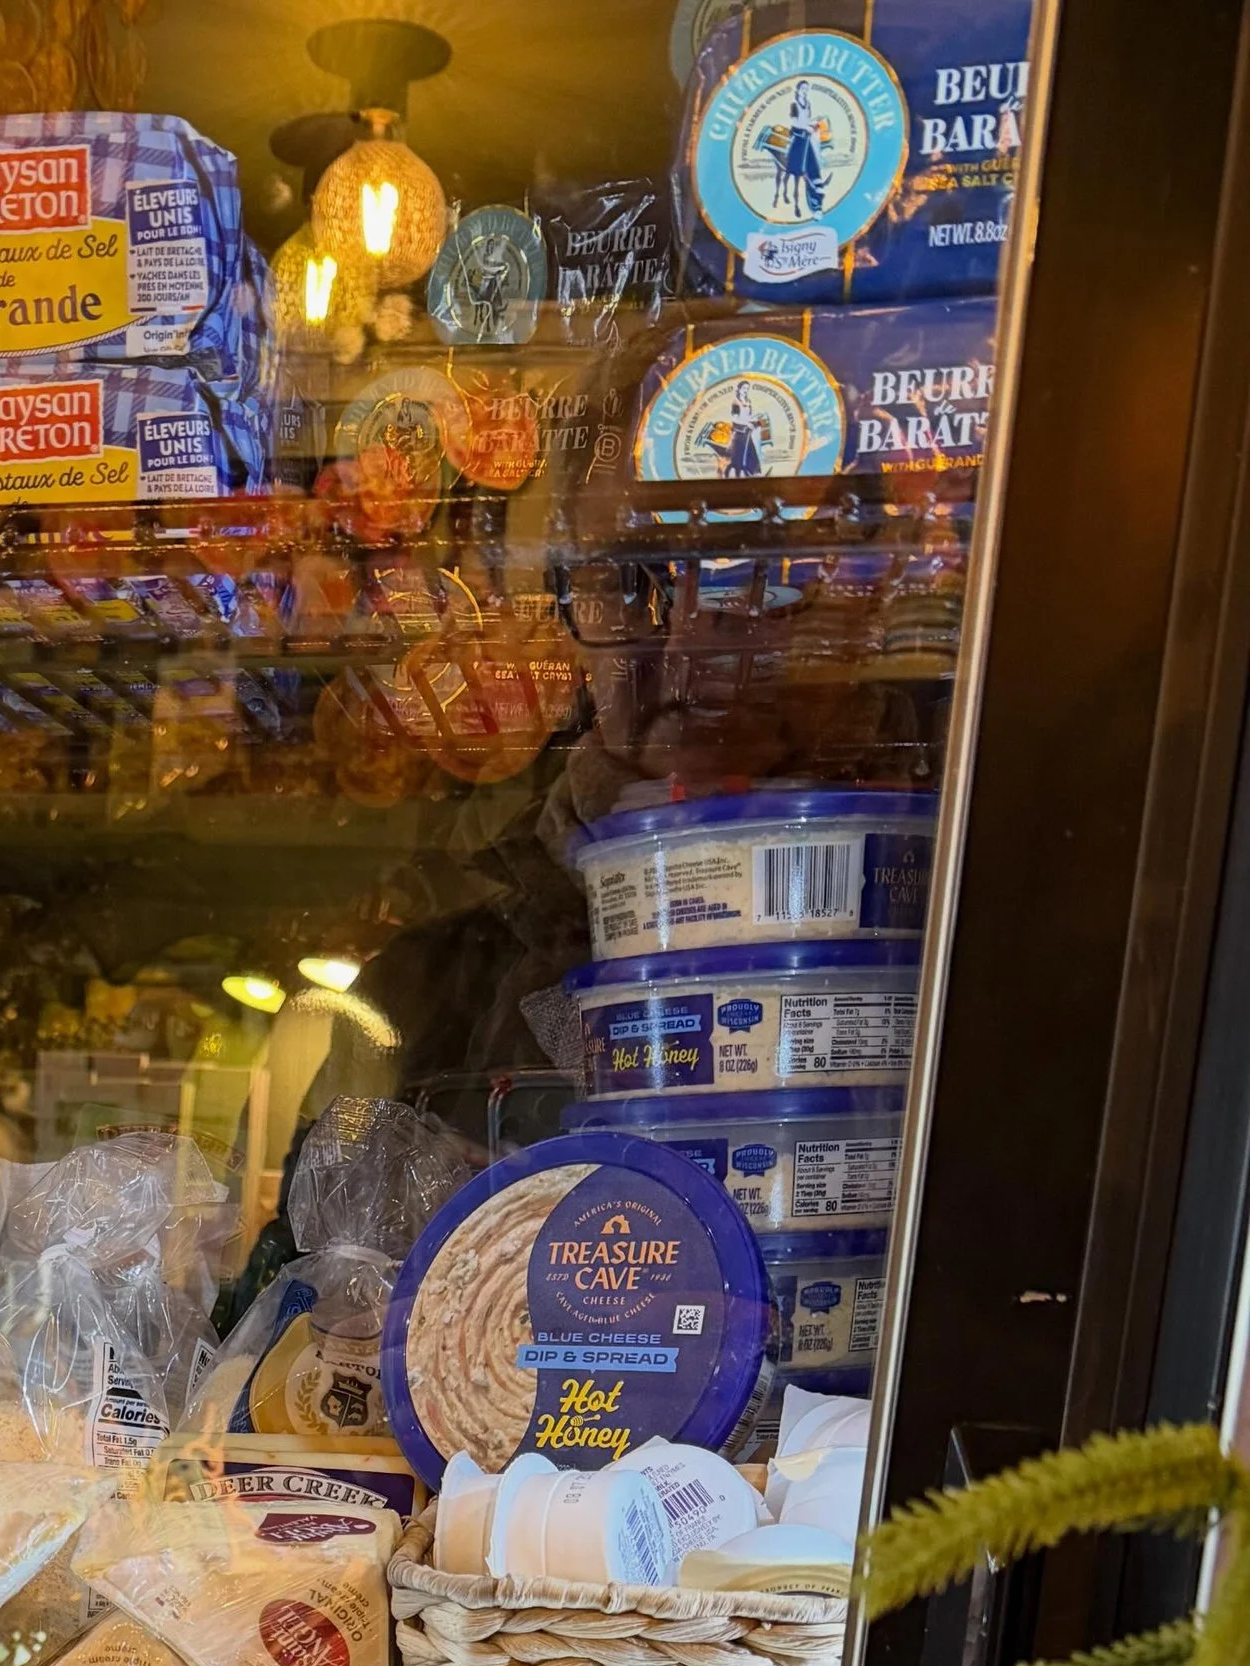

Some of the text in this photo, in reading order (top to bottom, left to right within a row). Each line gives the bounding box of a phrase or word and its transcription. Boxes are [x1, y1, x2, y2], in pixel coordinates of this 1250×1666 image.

[709, 43, 815, 140] CHURNED
[819, 44, 895, 135] BUTTER
[134, 188, 198, 212] ÉLEVEURS
[150, 207, 193, 228] UNIS
[138, 228, 177, 240] POUR LE
[929, 225, 955, 247] NET
[46, 238, 71, 260] de
[77, 234, 118, 259] Sel
[780, 239, 816, 255] Isigny
[784, 998, 827, 1010] Nutrition
[814, 1057, 826, 1069] 80
[575, 1200, 661, 1227] AMERICA'S ORIGINAL
[549, 1240, 680, 1265] TREASURE
[575, 1266, 639, 1290] CAVE
[583, 1295, 625, 1306] CHEESE
[538, 1332, 661, 1344] BLUE CHEESE
[524, 1350, 668, 1365] DIP & SPREAD
[560, 1379, 624, 1414] Hot
[101, 1404, 161, 1426] Calories
[535, 1414, 630, 1461] Honey
[199, 1474, 385, 1508] DEER CREEK
